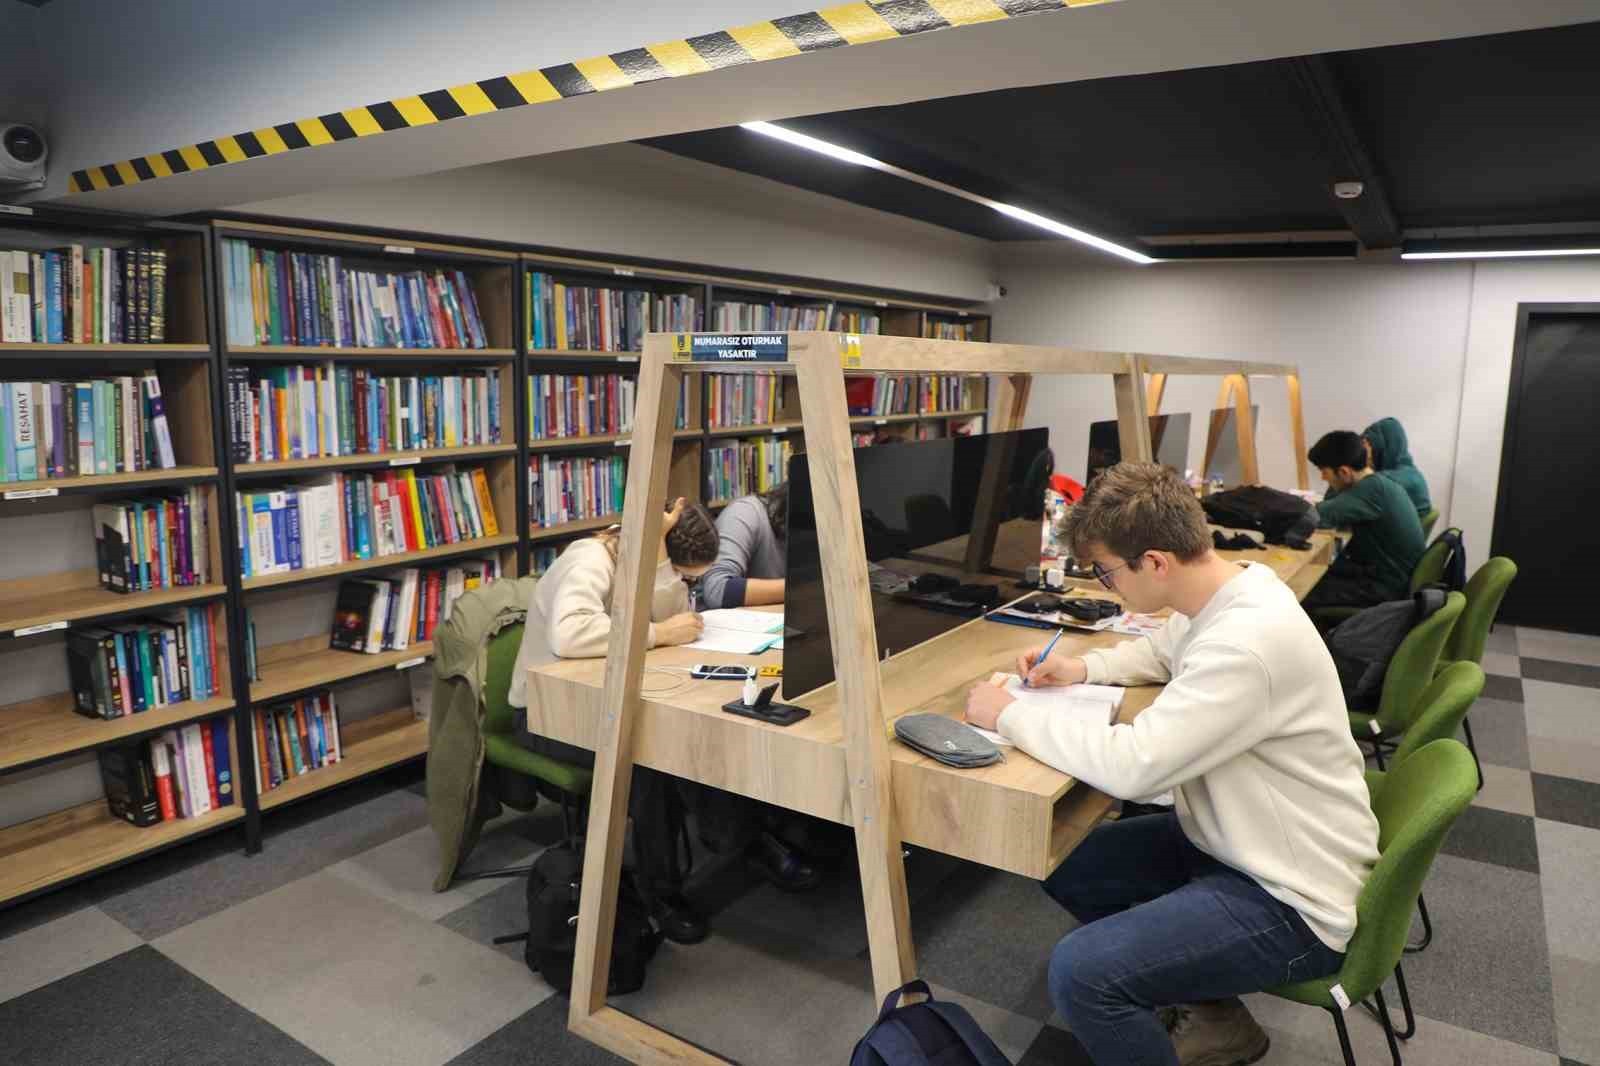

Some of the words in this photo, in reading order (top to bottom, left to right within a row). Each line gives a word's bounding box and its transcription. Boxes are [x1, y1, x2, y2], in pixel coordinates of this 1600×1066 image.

[694, 336, 741, 346] NUMARASIZ
[741, 335, 782, 345] OTURMAK
[718, 349, 758, 359] YASAKTIR
